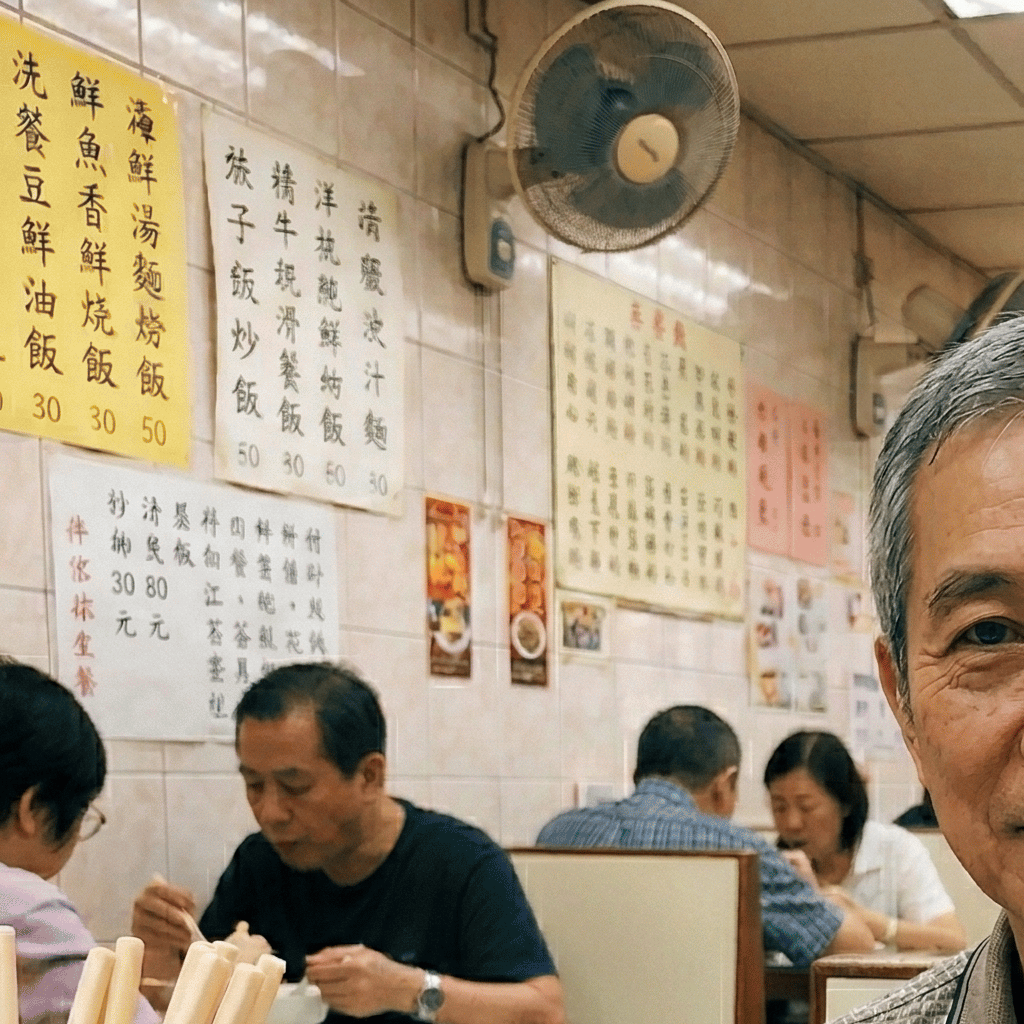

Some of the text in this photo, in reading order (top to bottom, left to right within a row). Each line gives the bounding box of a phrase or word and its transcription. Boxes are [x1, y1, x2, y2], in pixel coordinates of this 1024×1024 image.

[32, 392, 62, 423] 30
[89, 405, 116, 434] 30
[141, 416, 167, 446] 50
